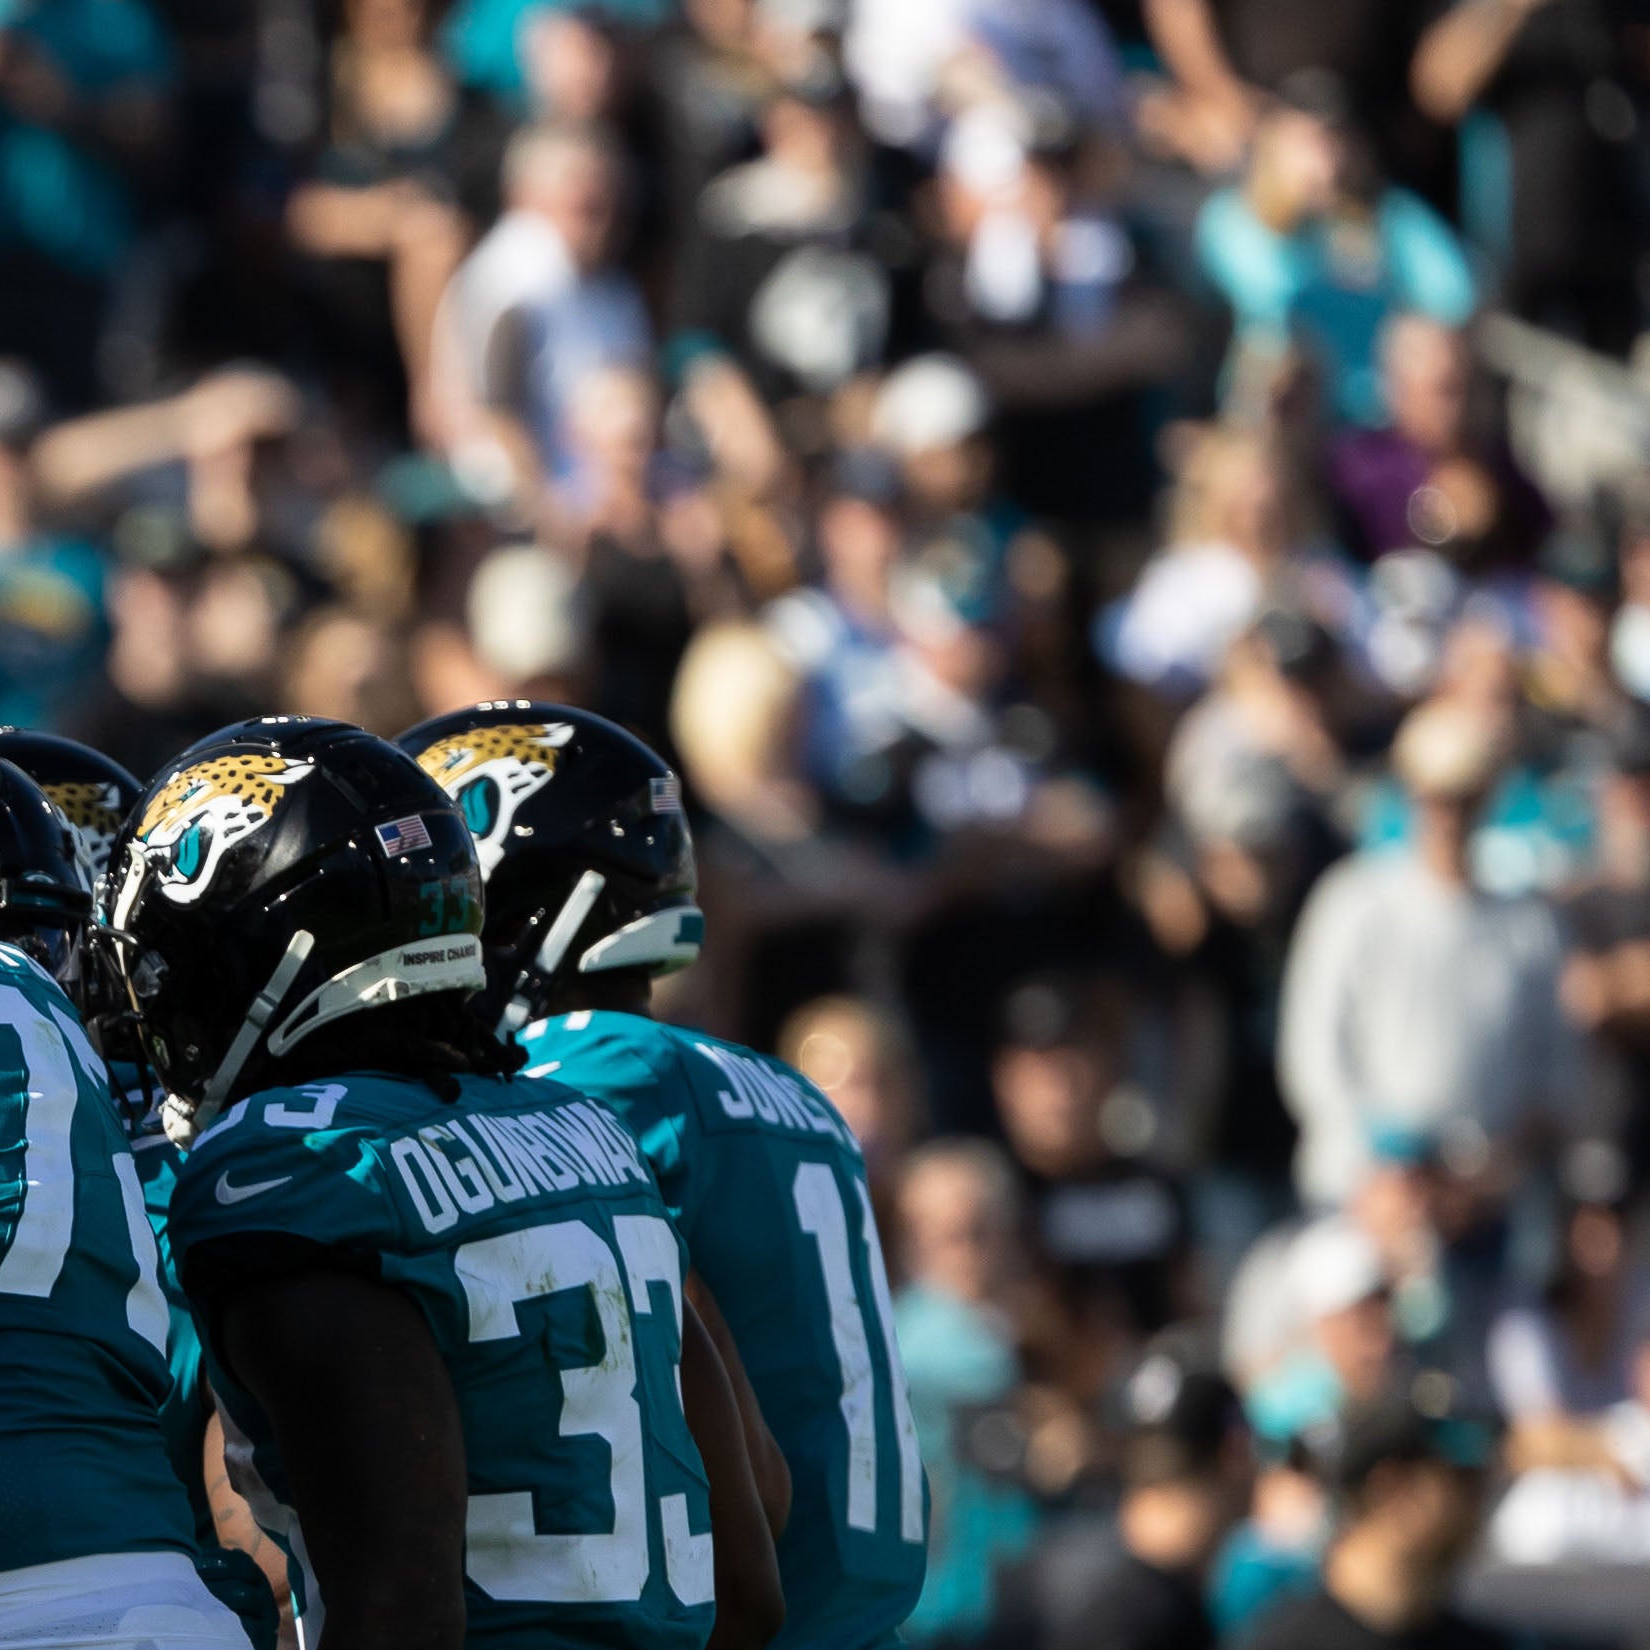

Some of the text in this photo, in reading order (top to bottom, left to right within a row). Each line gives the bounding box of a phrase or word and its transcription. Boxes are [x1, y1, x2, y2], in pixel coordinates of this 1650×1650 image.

[418, 877, 470, 936] 33
[404, 950, 445, 966] INSPIRE
[792, 1161, 925, 1544] 11
